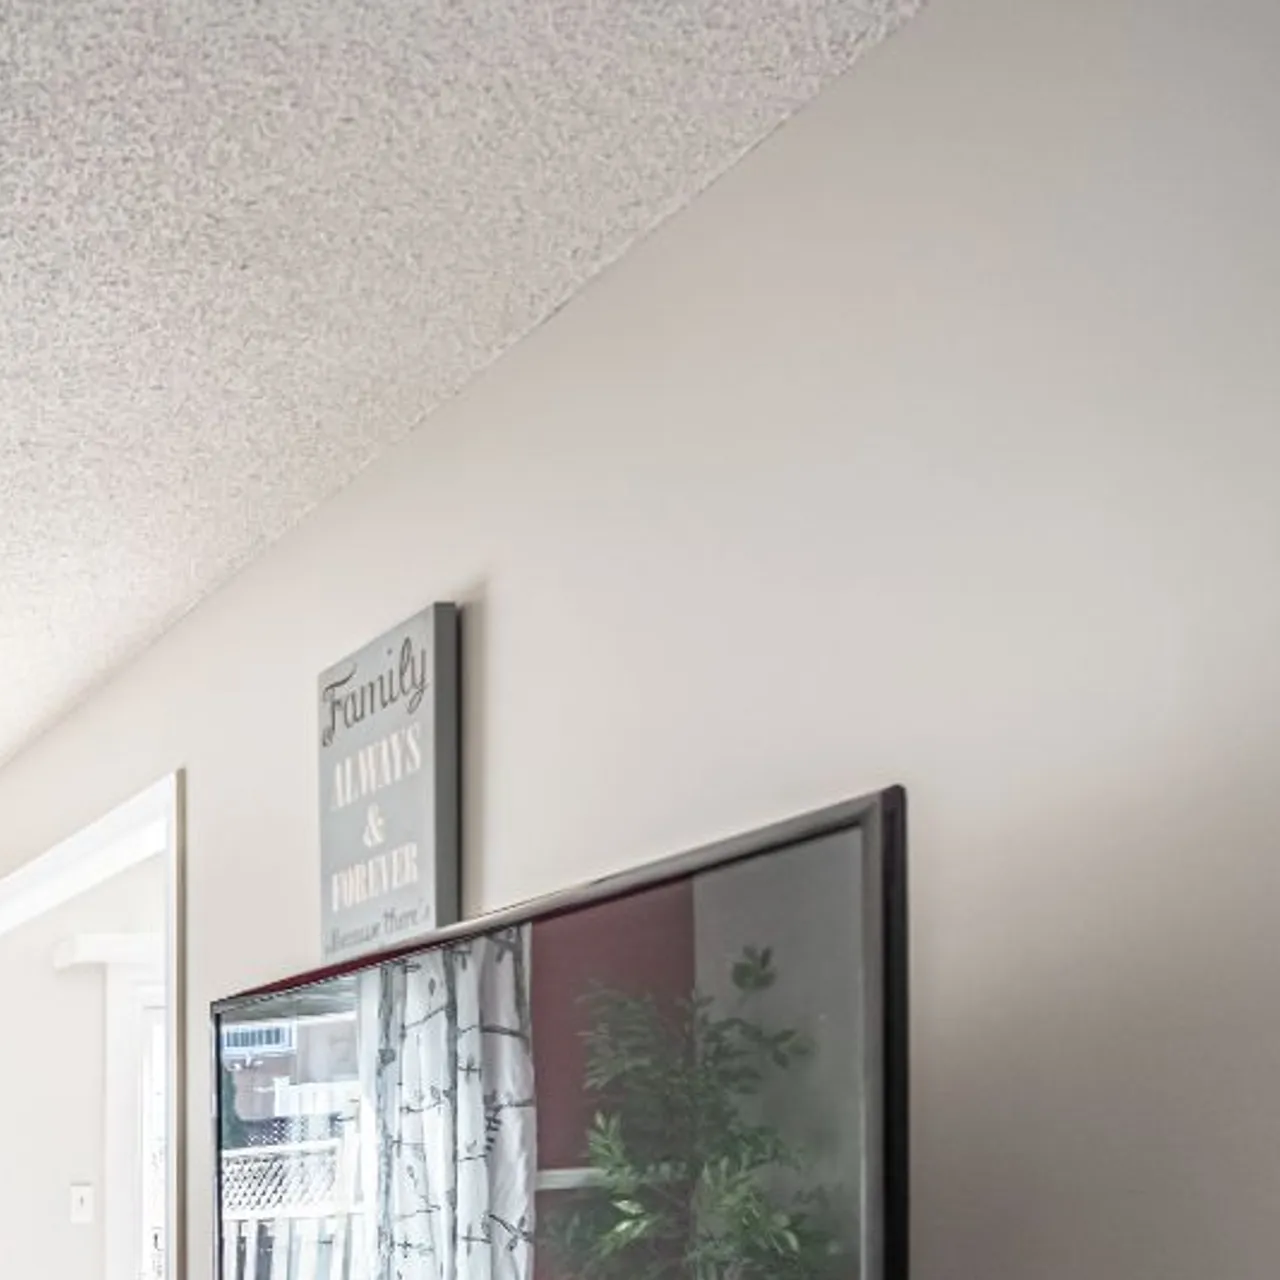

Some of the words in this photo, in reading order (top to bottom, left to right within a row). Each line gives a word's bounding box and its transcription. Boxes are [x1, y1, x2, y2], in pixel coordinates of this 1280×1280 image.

[321, 635, 430, 747] Family
[331, 722, 422, 809] ALWAYS
[362, 802, 385, 848] &
[331, 842, 419, 912] FOREVER
